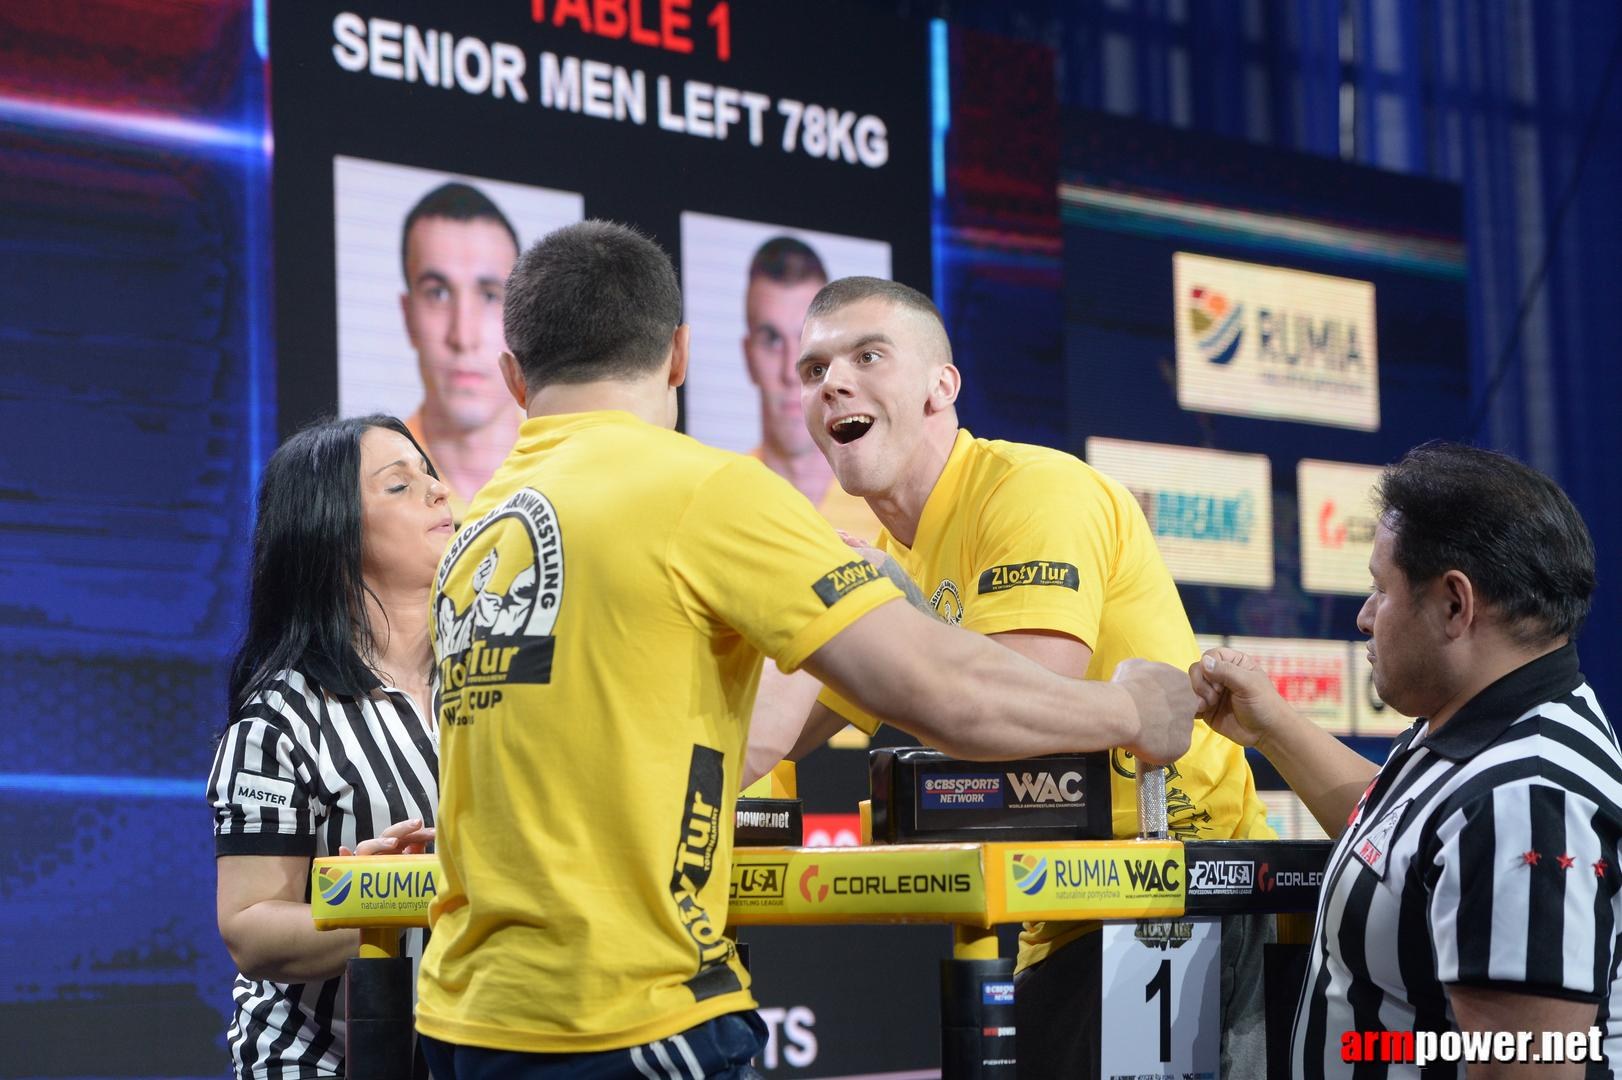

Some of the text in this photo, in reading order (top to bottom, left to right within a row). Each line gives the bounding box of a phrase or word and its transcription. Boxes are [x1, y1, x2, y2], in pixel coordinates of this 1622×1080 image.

[707, 1, 731, 61] 1
[332, 12, 889, 168] SENIOR MEN LEFT 78KG
[1256, 306, 1367, 373] RUMIA
[469, 690, 502, 710] CUP
[237, 785, 287, 806] MASTER
[940, 793, 985, 803] NETWORK
[1006, 771, 1084, 803] WAC
[735, 811, 790, 829] power.net
[704, 807, 719, 872] TOURNAMENT
[360, 871, 437, 899] RUMIA
[740, 869, 778, 892] USA
[832, 873, 971, 896] CORLEONIS
[1055, 859, 1120, 888] RUMIA
[1124, 859, 1180, 891] WAC
[361, 899, 429, 911] naturalnie pomysło
[1145, 959, 1172, 1063] 1
[750, 1006, 818, 1070] TS
